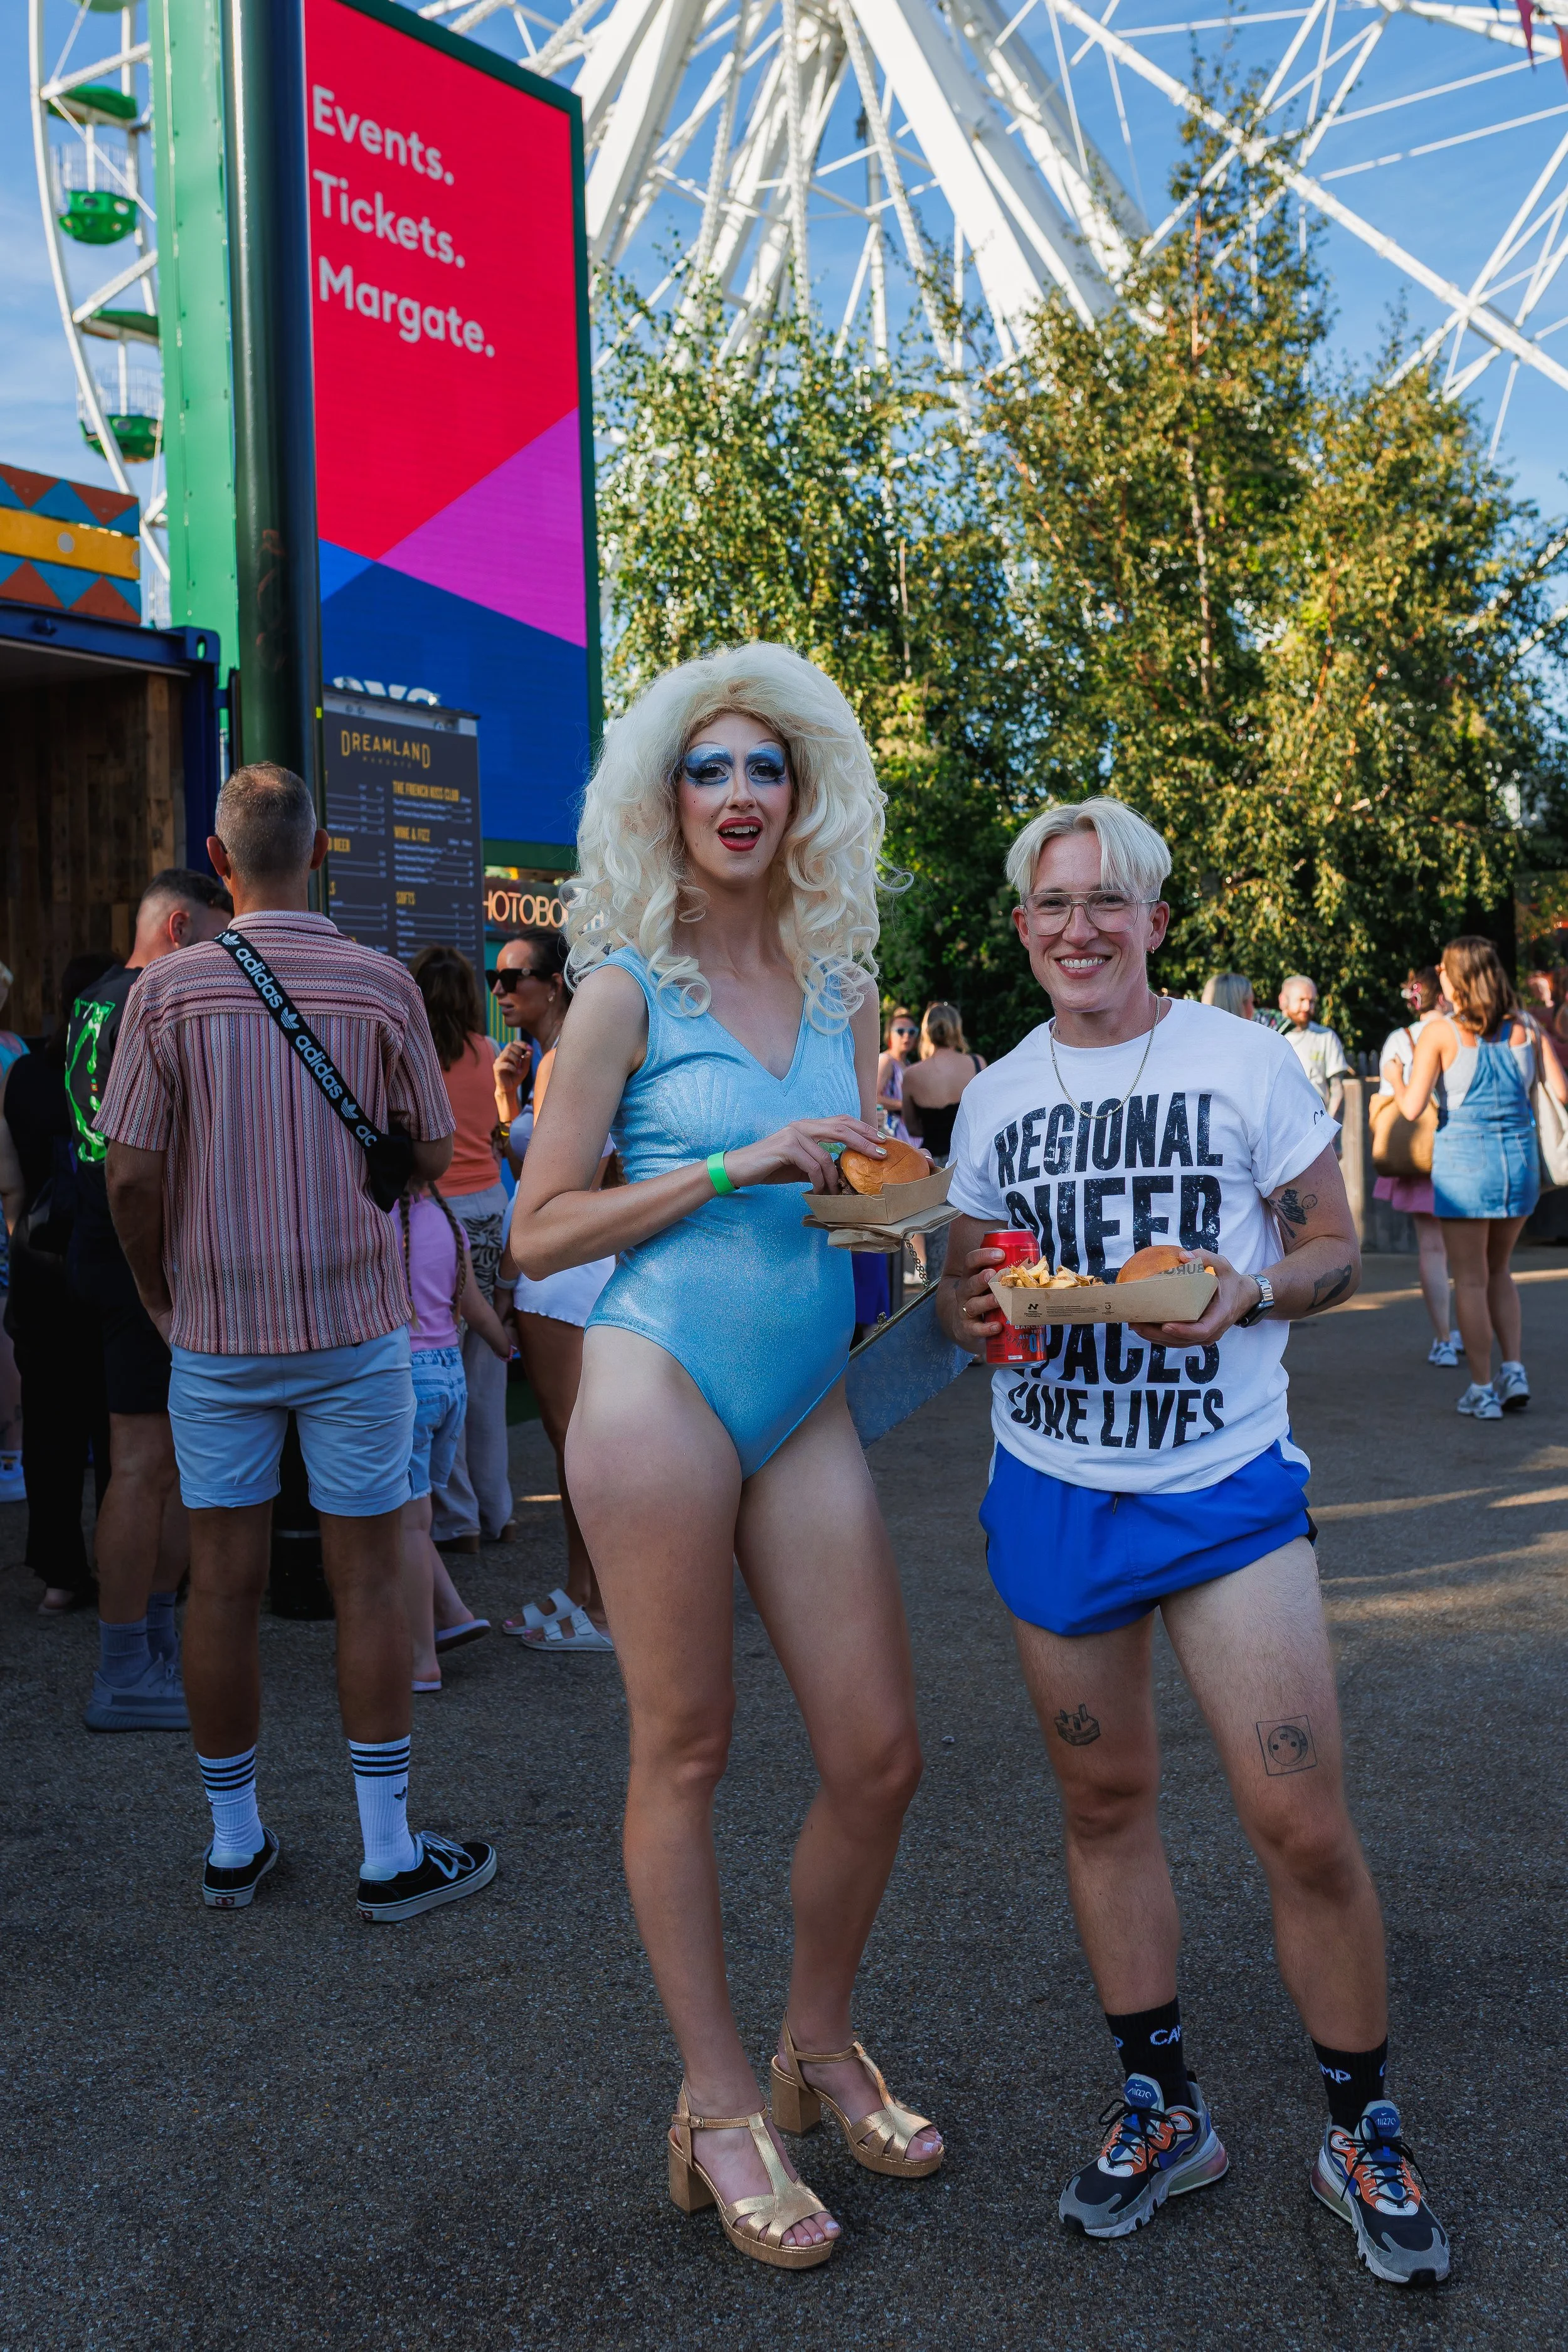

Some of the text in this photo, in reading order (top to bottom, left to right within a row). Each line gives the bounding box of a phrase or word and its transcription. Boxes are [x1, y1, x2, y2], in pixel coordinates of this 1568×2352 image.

[313, 84, 454, 186] Events.
[313, 169, 465, 268] Tickets.
[319, 255, 495, 358] Margate.
[341, 730, 431, 769] DREAMLAND
[236, 948, 283, 1009] adidas
[295, 1035, 343, 1099] adidas
[994, 1092, 1224, 1189] REGIONAL
[1005, 1174, 1222, 1285] QUEER
[1100, 1388, 1225, 1450] LIVES
